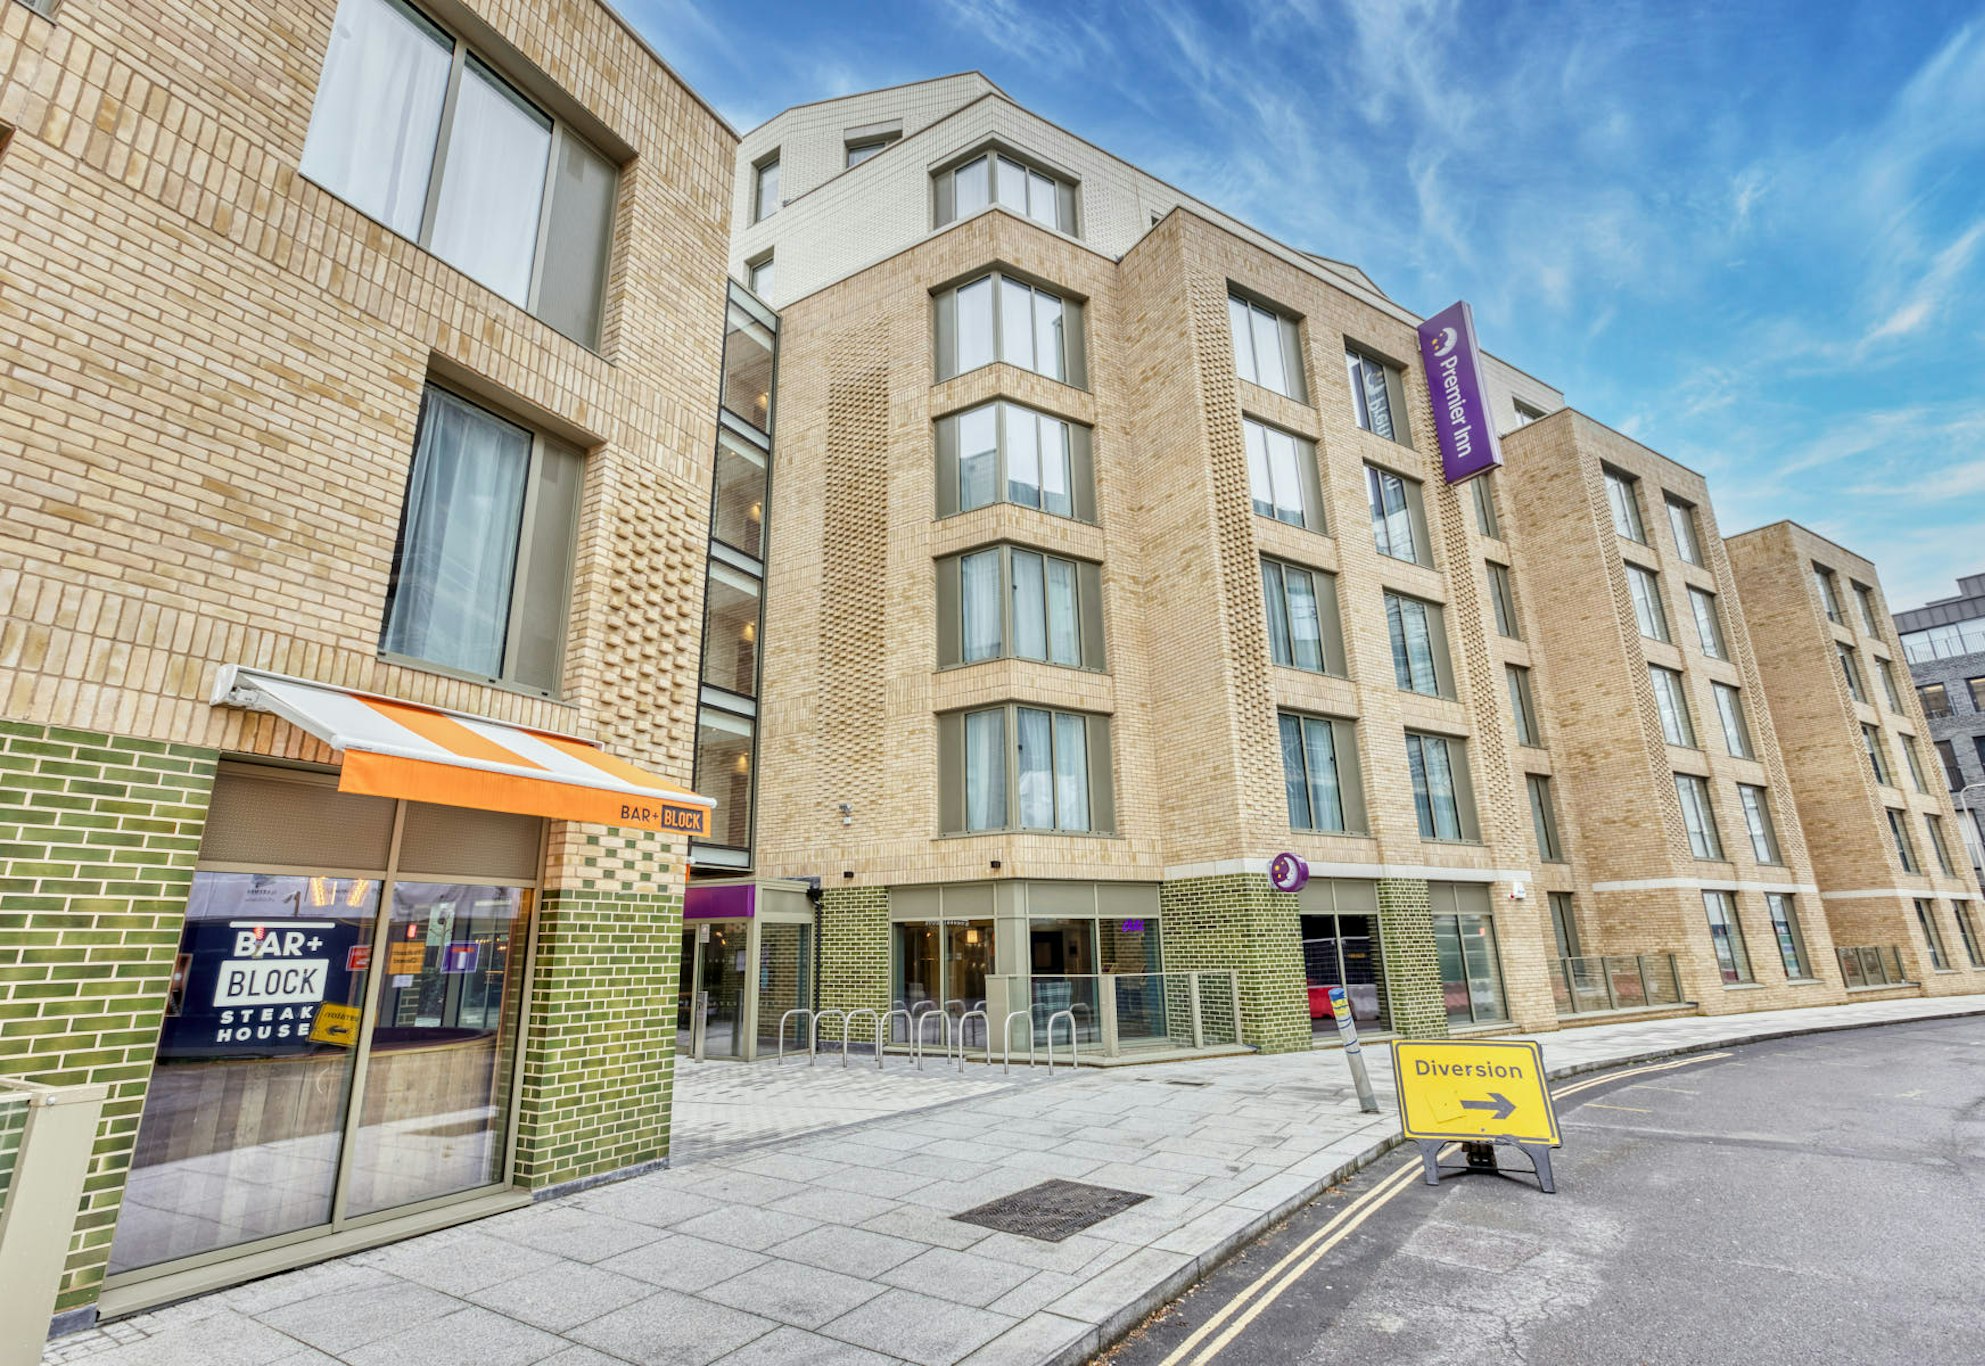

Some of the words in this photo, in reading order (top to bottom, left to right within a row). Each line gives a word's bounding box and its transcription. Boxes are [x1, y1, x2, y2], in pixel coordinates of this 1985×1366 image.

[1440, 355, 1466, 425] Premier
[1453, 425, 1472, 458] Inn
[664, 809, 701, 829] BLOCK
[234, 931, 323, 957] BAR+
[227, 968, 318, 997] BLOCK
[220, 1006, 314, 1025] STEAK
[216, 1023, 311, 1043] HOUSE
[1415, 1059, 1523, 1079] Diversion
